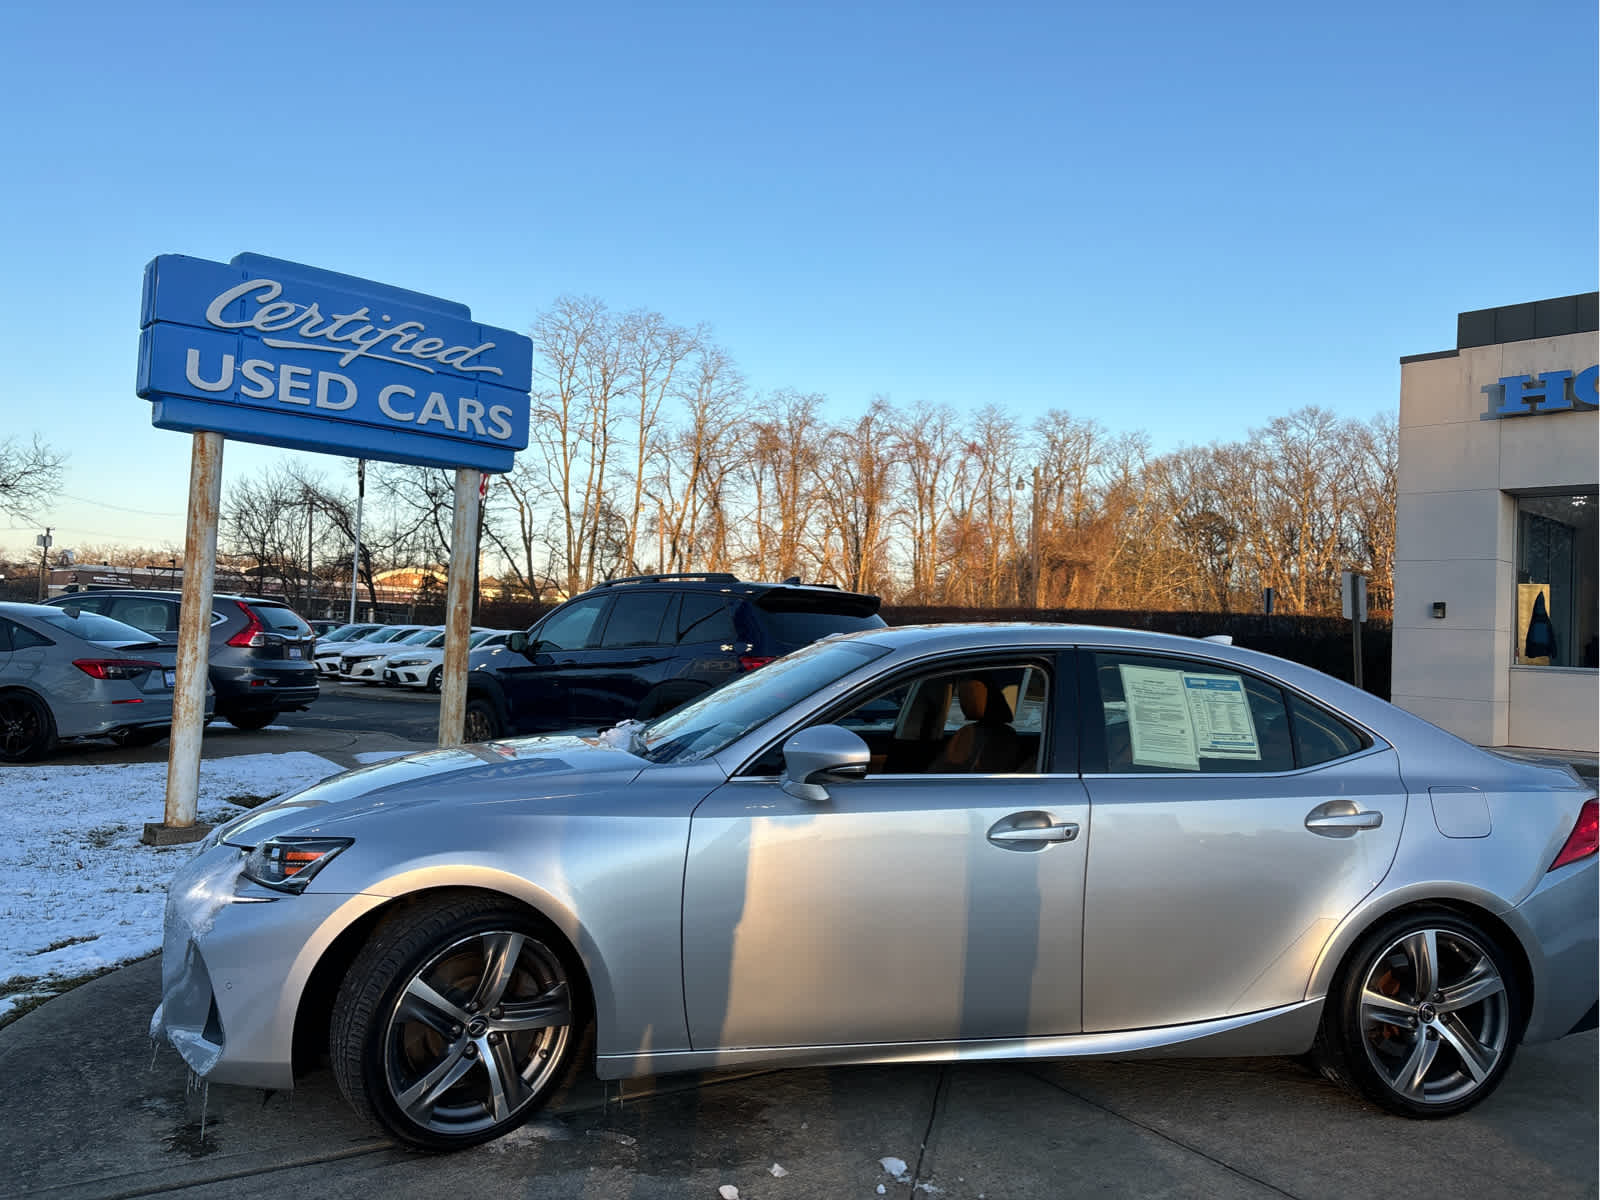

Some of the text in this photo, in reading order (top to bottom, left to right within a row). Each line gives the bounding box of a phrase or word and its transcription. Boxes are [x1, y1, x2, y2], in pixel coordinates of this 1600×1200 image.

[205, 278, 503, 376] Certified
[185, 348, 514, 440] USED CARS
